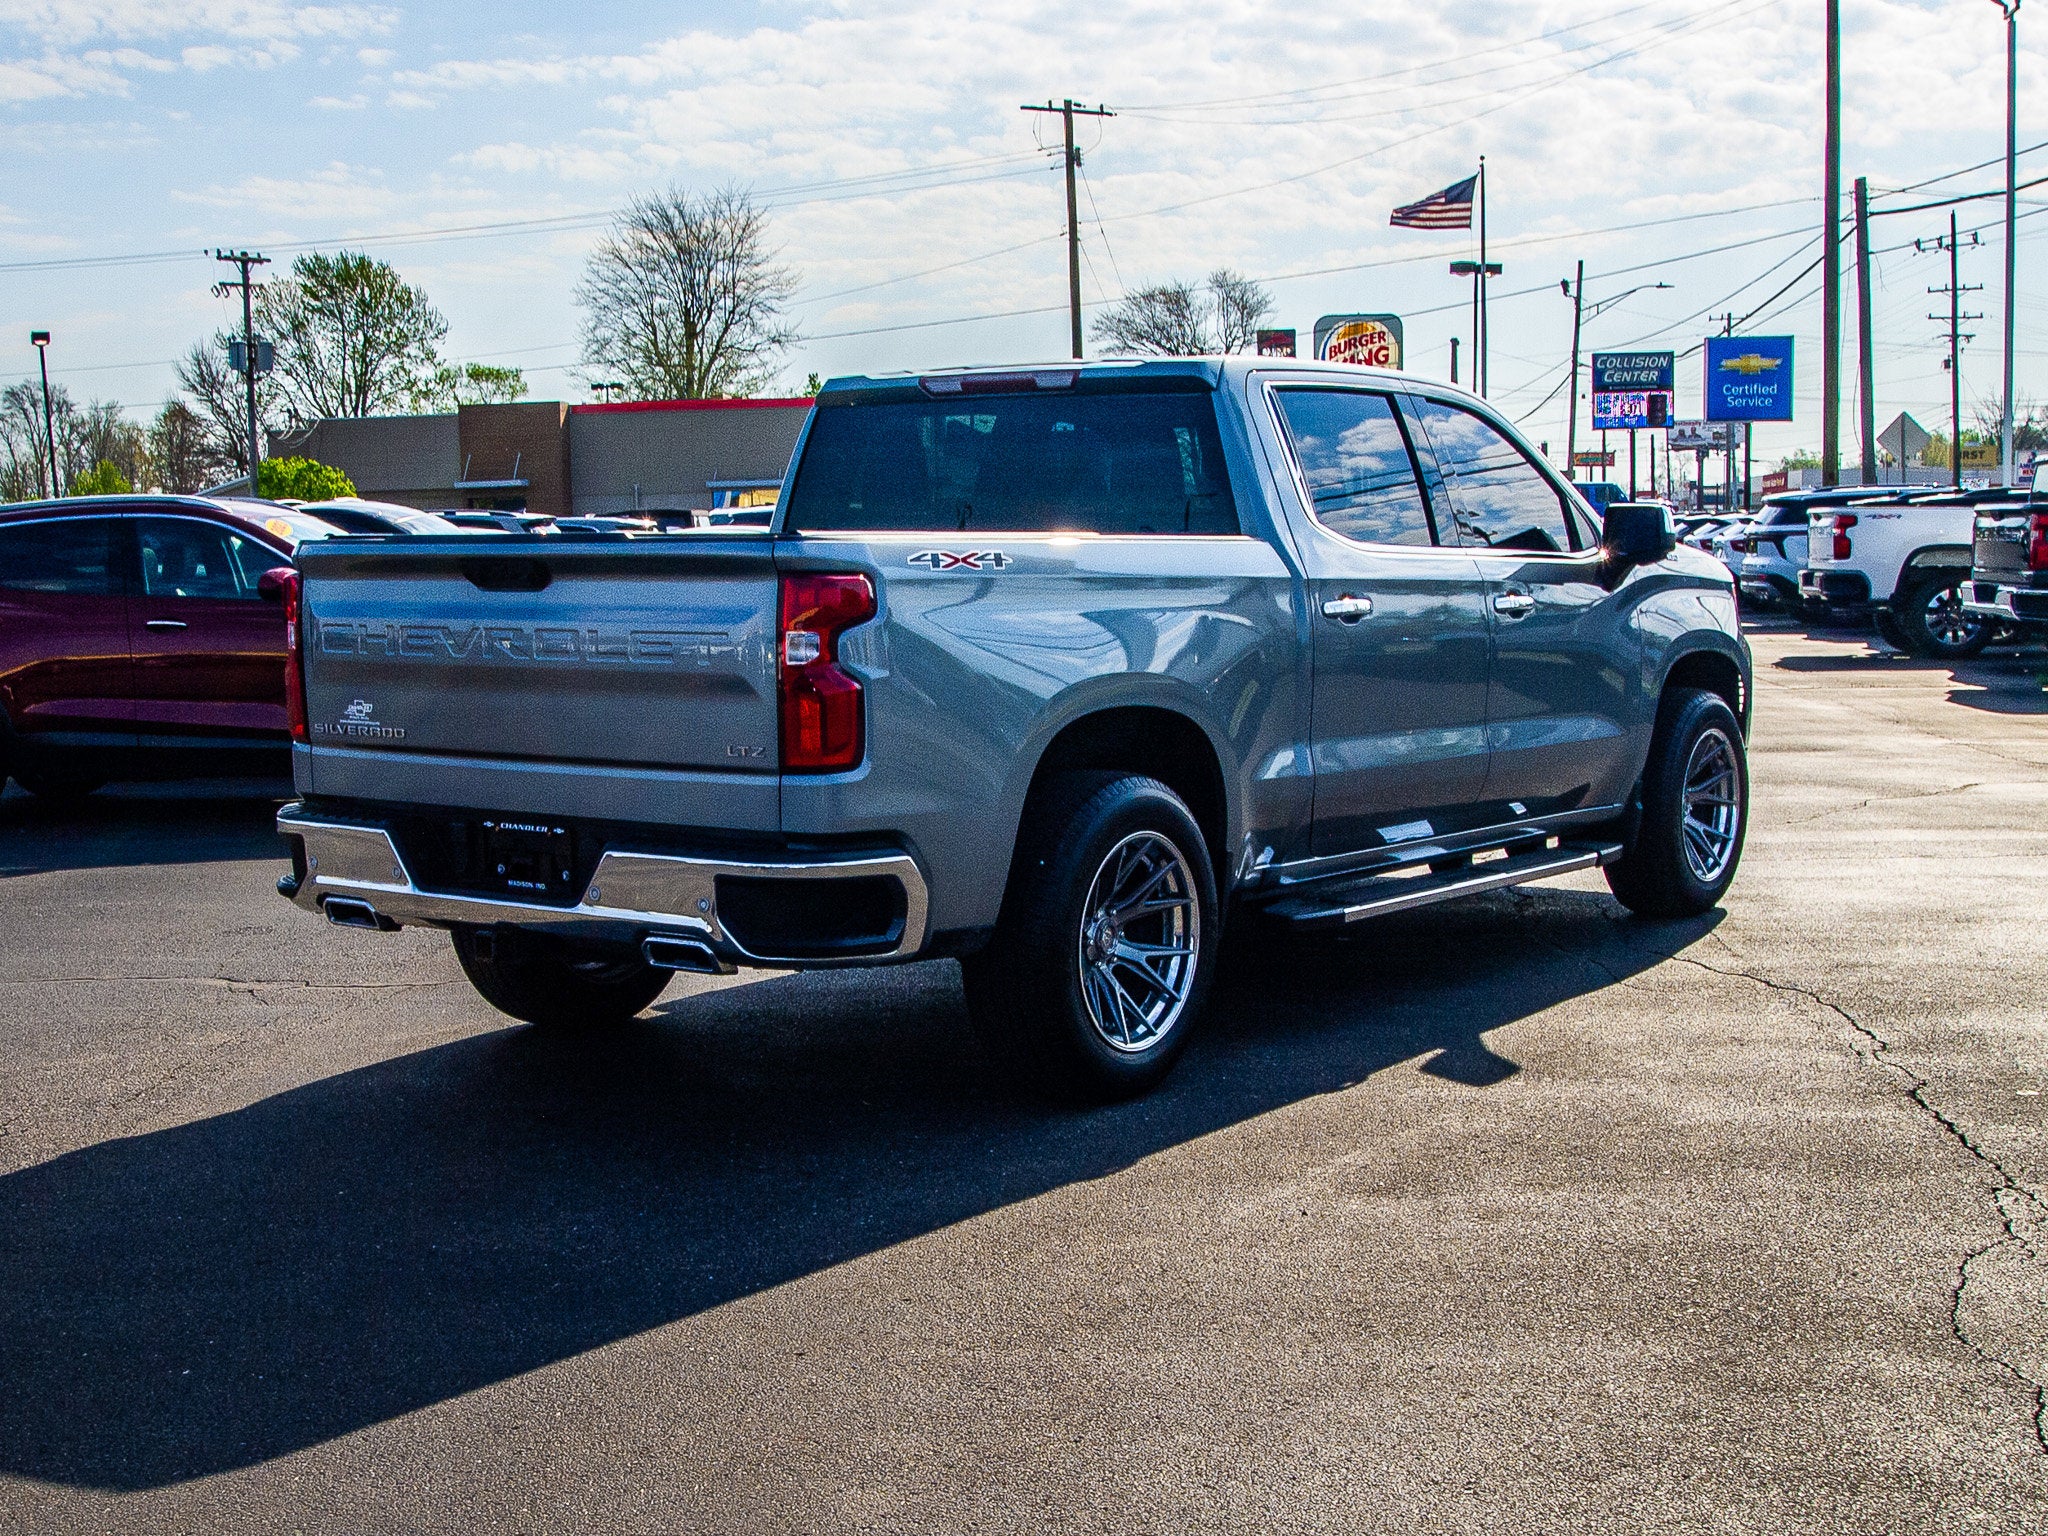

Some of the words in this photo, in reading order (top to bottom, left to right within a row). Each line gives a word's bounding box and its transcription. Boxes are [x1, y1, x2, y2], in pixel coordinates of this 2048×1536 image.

[1328, 330, 1387, 361] BURGER
[1336, 345, 1390, 366] ING
[1596, 355, 1669, 369] COLLISION
[1604, 370, 1659, 382] CENTER
[1722, 383, 1778, 396] Certified
[1727, 396, 1773, 408] Service
[321, 623, 729, 667] CHEVROLET
[314, 723, 405, 738] SILVERADO
[726, 744, 766, 758] LTZ
[500, 822, 548, 832] CHANDLER
